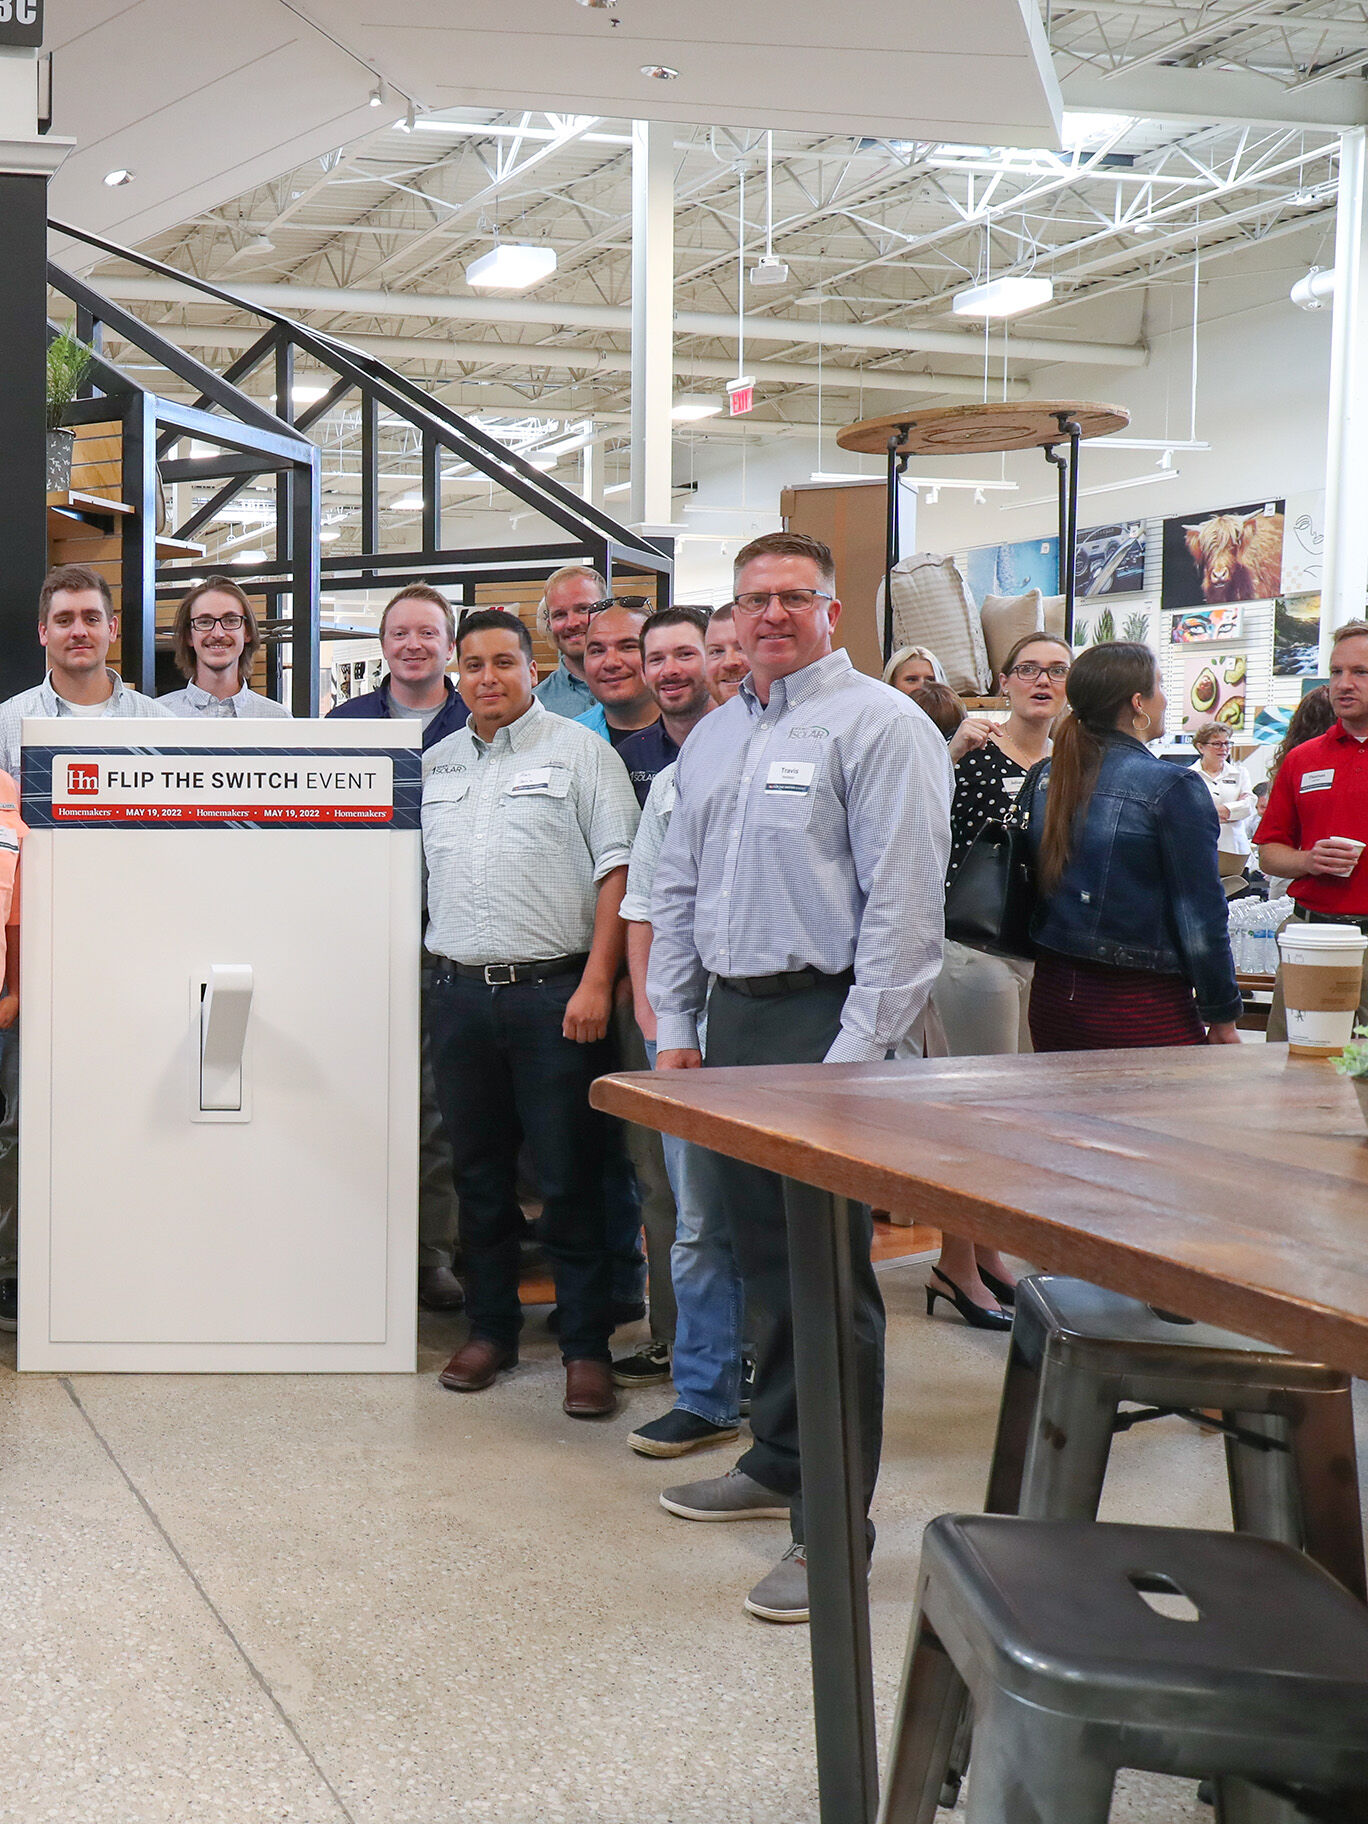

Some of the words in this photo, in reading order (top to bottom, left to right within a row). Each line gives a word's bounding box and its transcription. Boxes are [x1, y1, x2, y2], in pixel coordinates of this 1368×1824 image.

[732, 388, 752, 413] EXIT
[436, 766, 462, 774] SOLAR
[781, 767, 799, 775] Travis
[67, 769, 99, 790] Hm
[107, 771, 154, 788] FLIP
[161, 772, 204, 789] THE
[211, 772, 299, 789] SWITCH
[306, 772, 377, 789] EVENT
[58, 807, 112, 817] Homemakers
[125, 808, 145, 817] MAY
[147, 808, 160, 819] 19,
[161, 808, 182, 817] 2022
[196, 808, 249, 818] Homemakers
[263, 809, 283, 818] MAY
[285, 809, 298, 819] 19,
[299, 809, 320, 818] 2022
[334, 809, 387, 818] Homemakers
